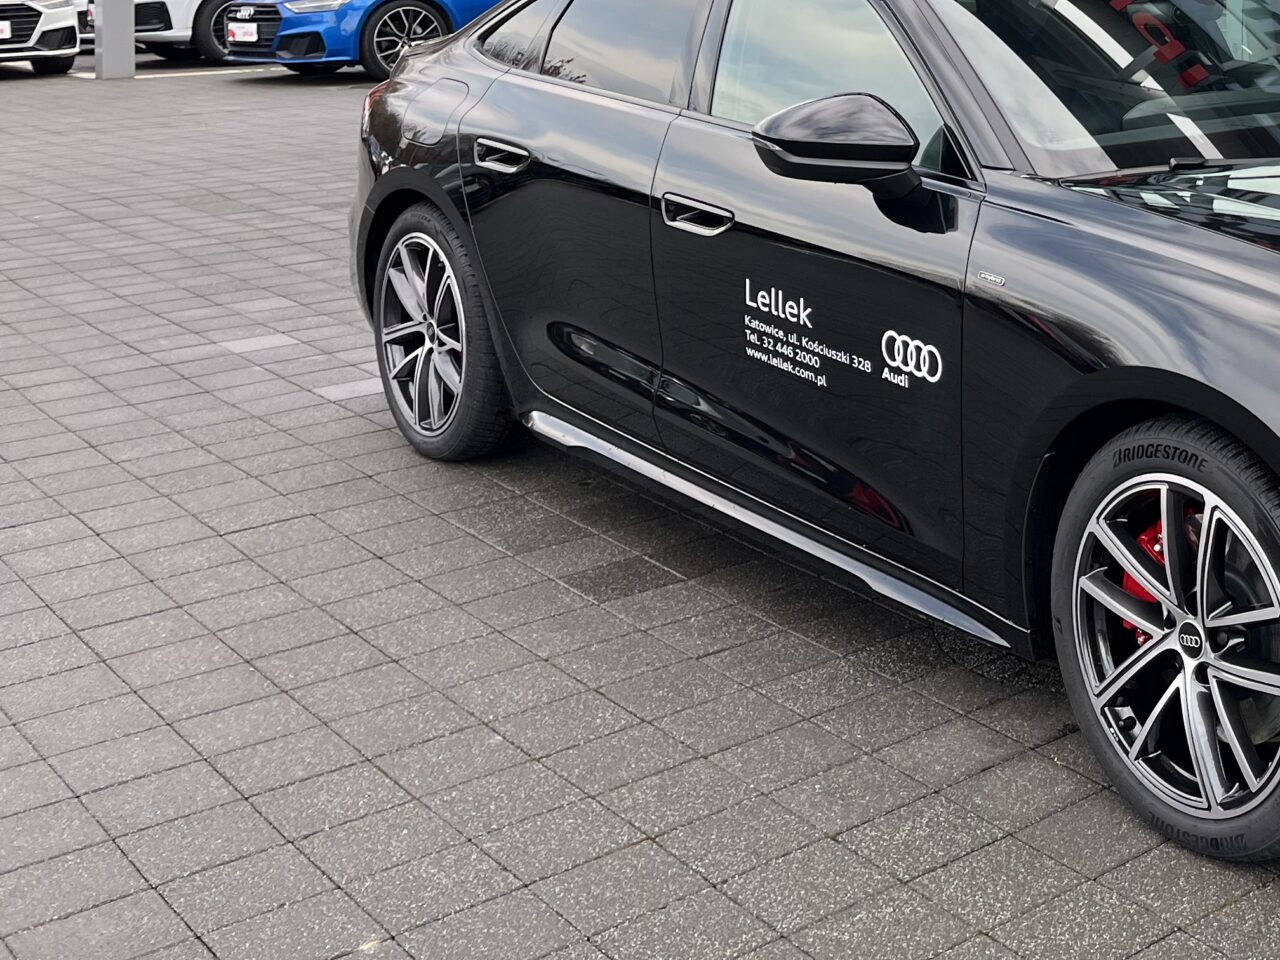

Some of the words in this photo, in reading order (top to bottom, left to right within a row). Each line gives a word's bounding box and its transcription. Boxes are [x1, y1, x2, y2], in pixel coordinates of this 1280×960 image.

[745, 278, 812, 328] Lellek
[744, 314, 787, 342] Katowice,
[788, 333, 800, 346] ul.
[801, 336, 850, 365] Kościuszki
[851, 355, 872, 373] 328
[744, 329, 761, 345] Tel.
[762, 336, 774, 351] 32
[775, 342, 794, 358] 446
[795, 349, 820, 368] 2000
[745, 346, 828, 387] www.lellek.com.pl
[881, 367, 909, 388] Audi
[1113, 443, 1209, 473] BRIDGESTONE
